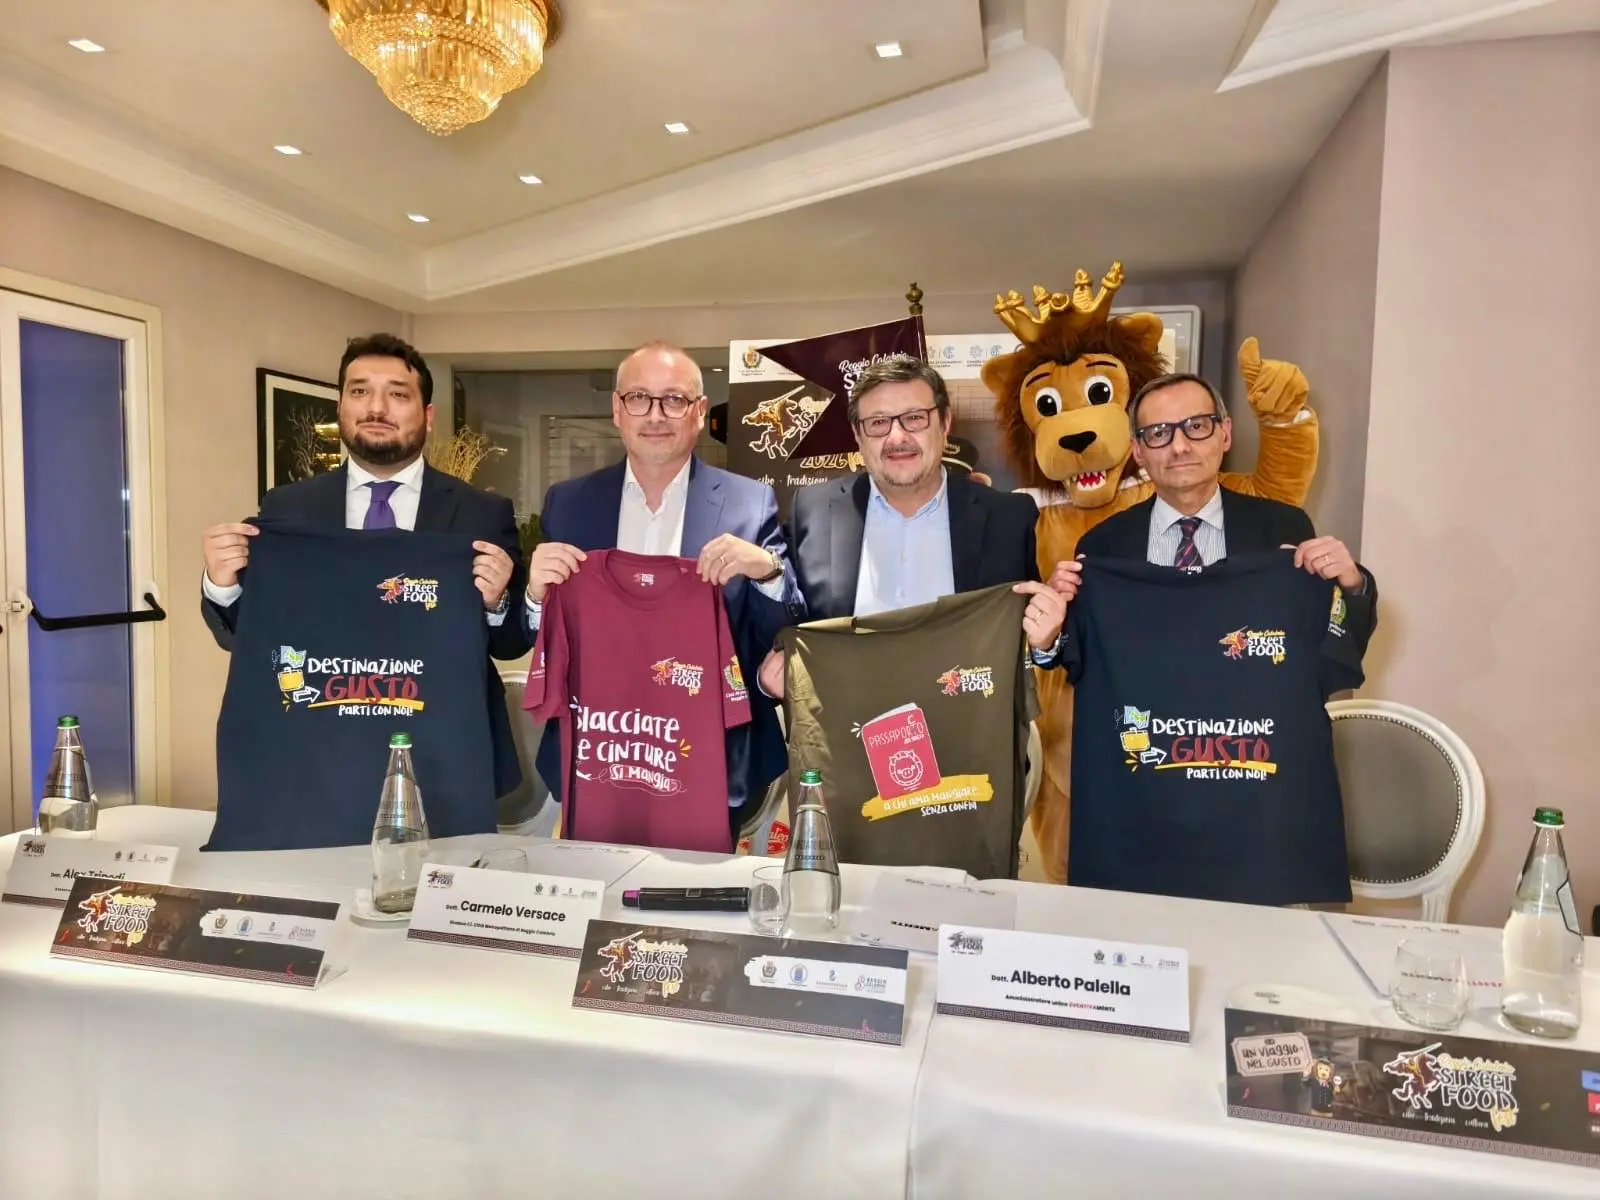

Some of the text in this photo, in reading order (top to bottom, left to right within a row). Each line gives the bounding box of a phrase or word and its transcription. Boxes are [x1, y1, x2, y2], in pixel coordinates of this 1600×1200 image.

[839, 358, 870, 373] Reggio
[403, 591, 438, 602] FOOD
[1248, 644, 1286, 657] FOOD
[324, 674, 418, 704] GUSTO
[671, 675, 702, 689] FOOD
[961, 680, 994, 692] FOOD
[372, 705, 392, 717] CON
[1171, 736, 1271, 767] GUSTO
[1222, 768, 1243, 779] CON
[460, 900, 513, 916] Carmelo
[516, 906, 566, 922] Versace
[104, 914, 148, 934] FOOD
[521, 927, 535, 935] Reggio
[631, 963, 683, 983] FOOD
[1010, 970, 1071, 989] Alberto
[1074, 977, 1131, 996] Palella
[1266, 1056, 1301, 1067] GUSTO
[1440, 1085, 1519, 1112] FOOD
